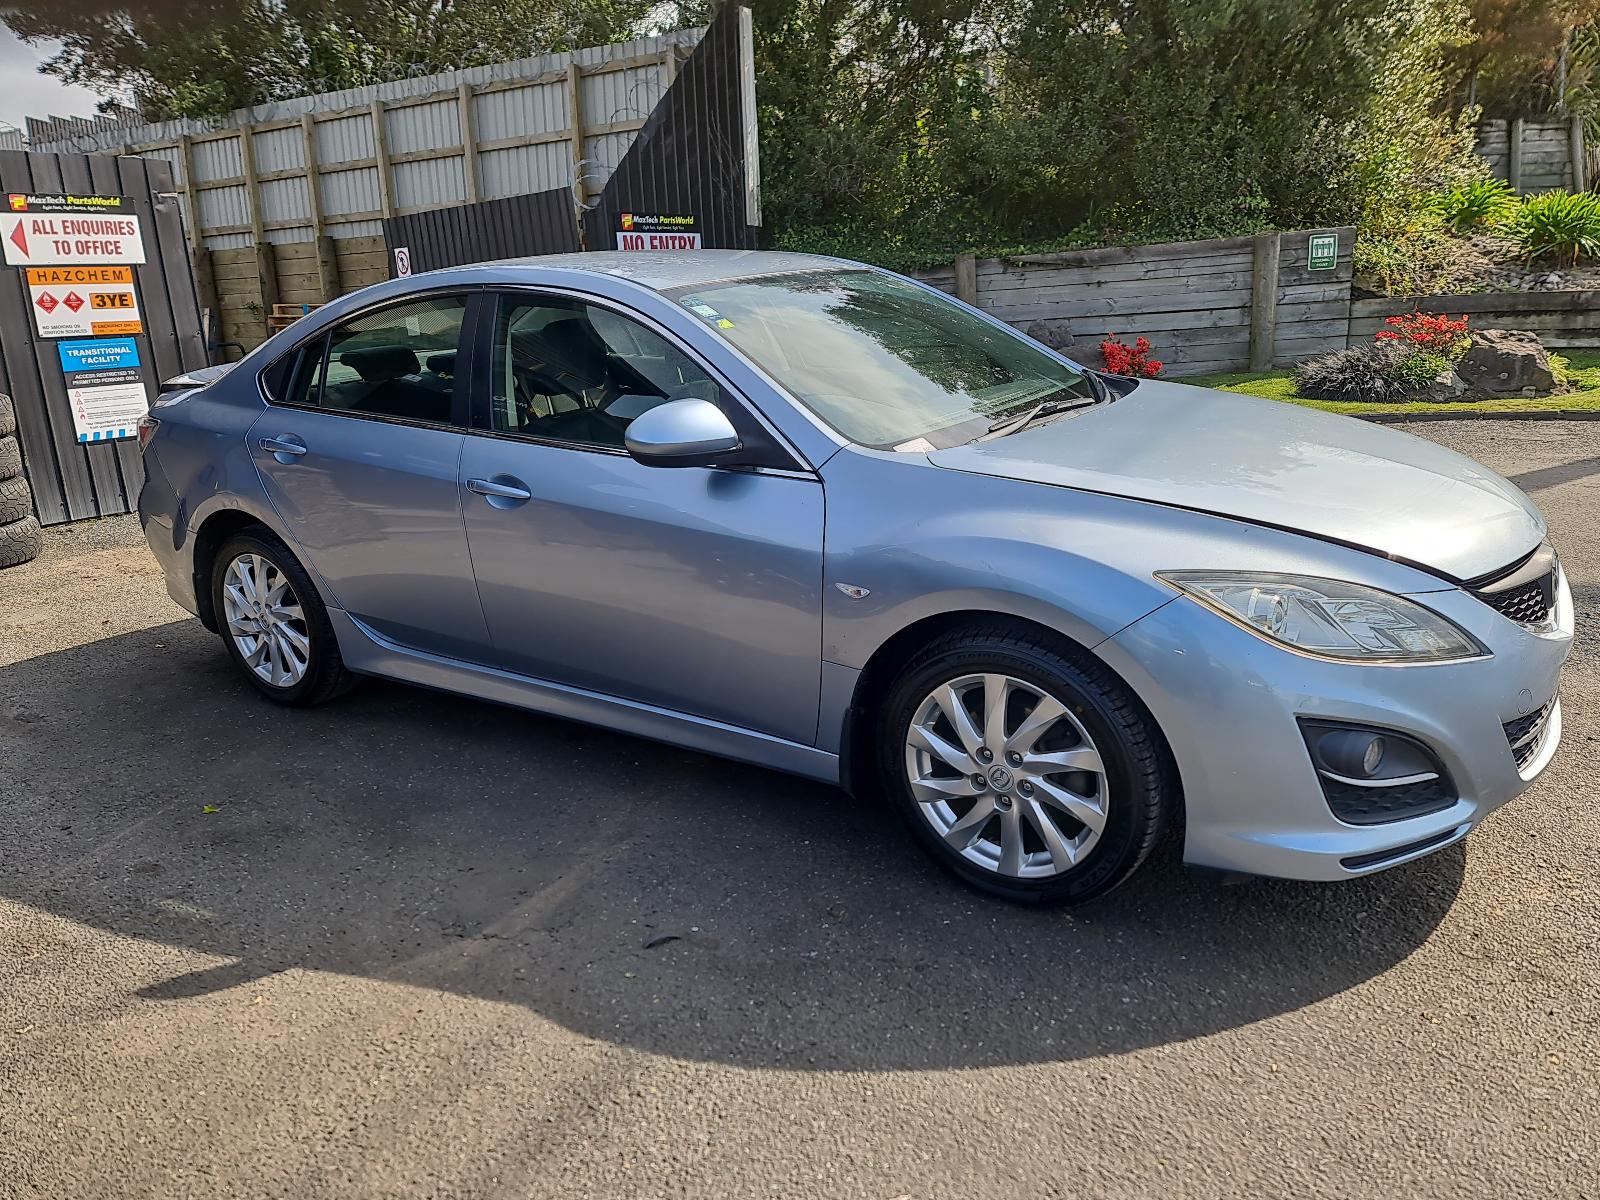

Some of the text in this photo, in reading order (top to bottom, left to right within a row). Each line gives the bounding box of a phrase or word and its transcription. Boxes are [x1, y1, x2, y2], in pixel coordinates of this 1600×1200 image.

[27, 196, 121, 206] MazTech PartsWorld
[659, 216, 694, 224] PartsWorld
[32, 220, 135, 236] ALL ENQUIRIES
[52, 240, 123, 255] TO OFFICE
[622, 235, 696, 250] NO ENTRY
[37, 270, 124, 282] HAZCHEM
[95, 294, 129, 308] 3YE
[67, 347, 132, 357] TRANSITIONAL
[81, 356, 121, 364] FACILITY
